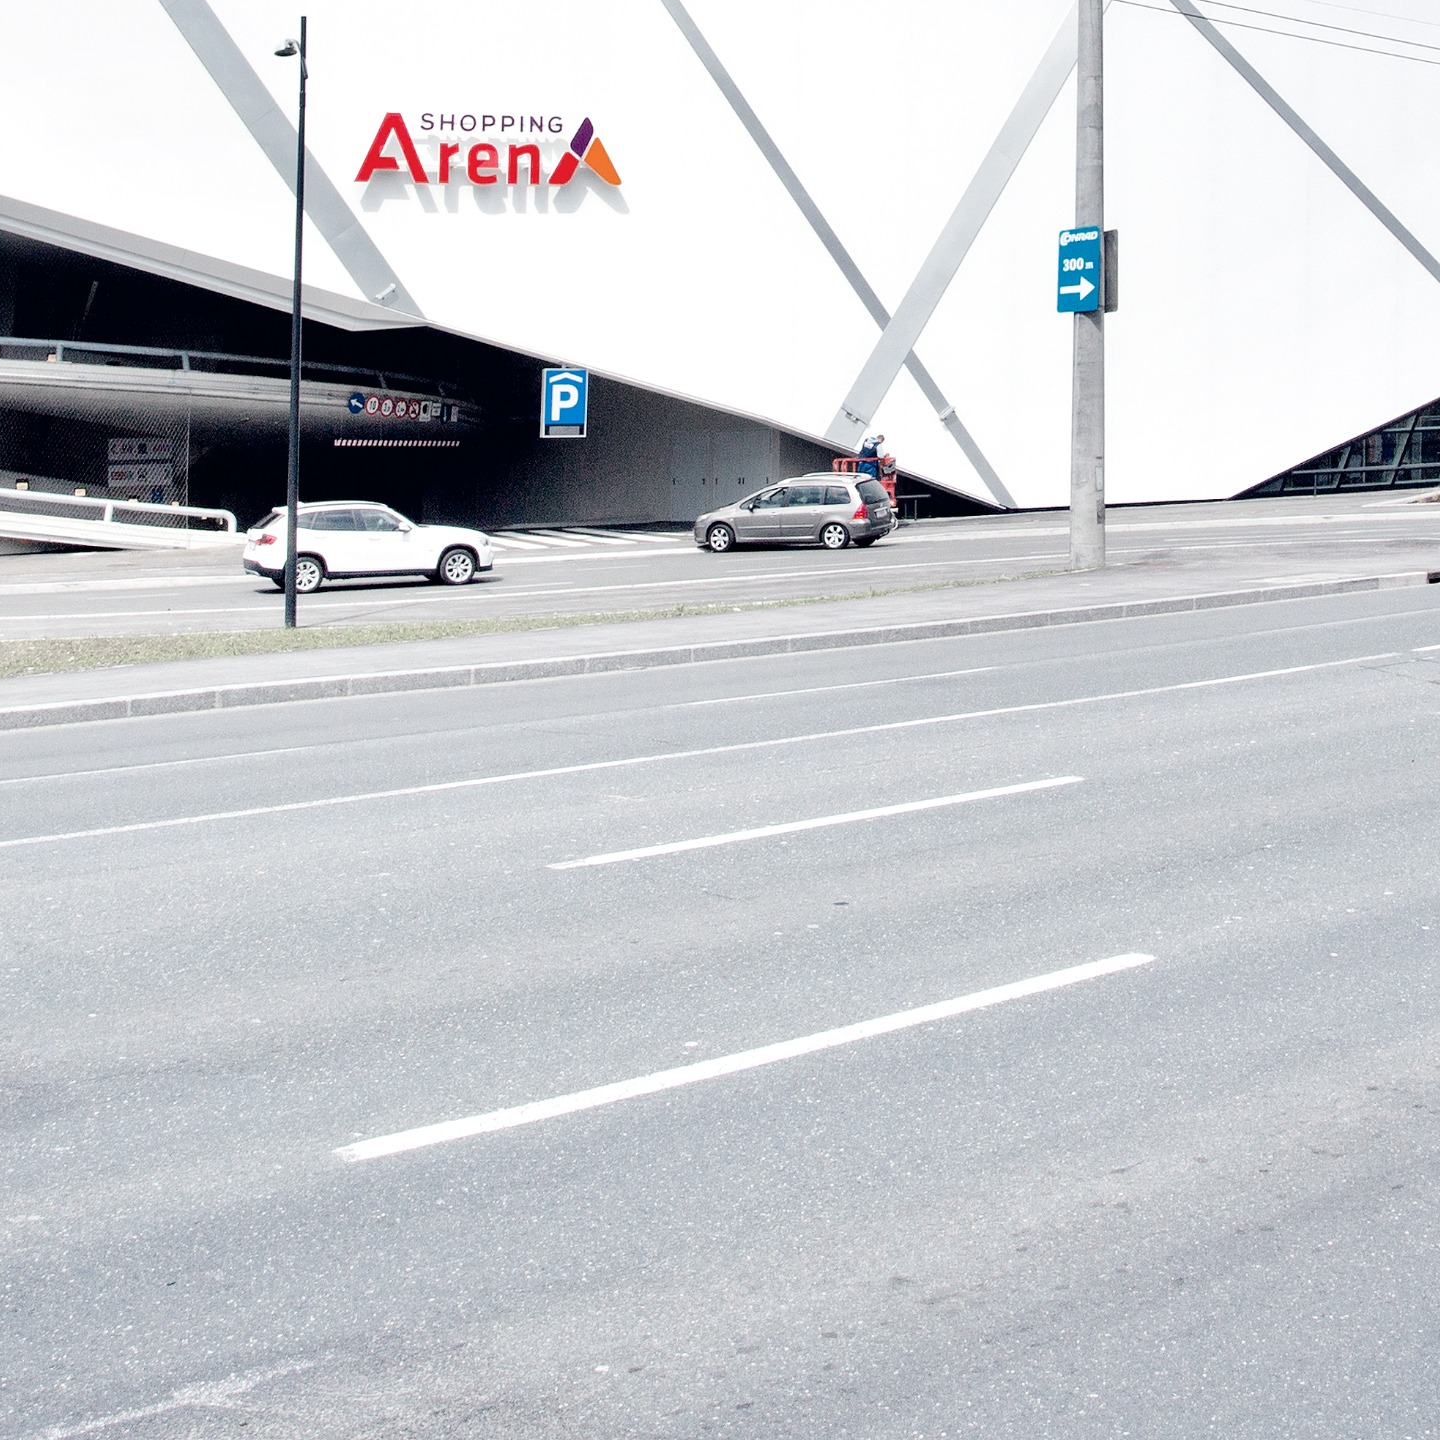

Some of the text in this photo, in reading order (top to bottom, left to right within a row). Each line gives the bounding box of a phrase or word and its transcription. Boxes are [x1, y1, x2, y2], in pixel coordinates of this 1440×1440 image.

[420, 113, 563, 133] SHOPPING
[1060, 231, 1099, 246] CONRAD
[1063, 257, 1094, 272] 300 m
[551, 384, 579, 421] P
